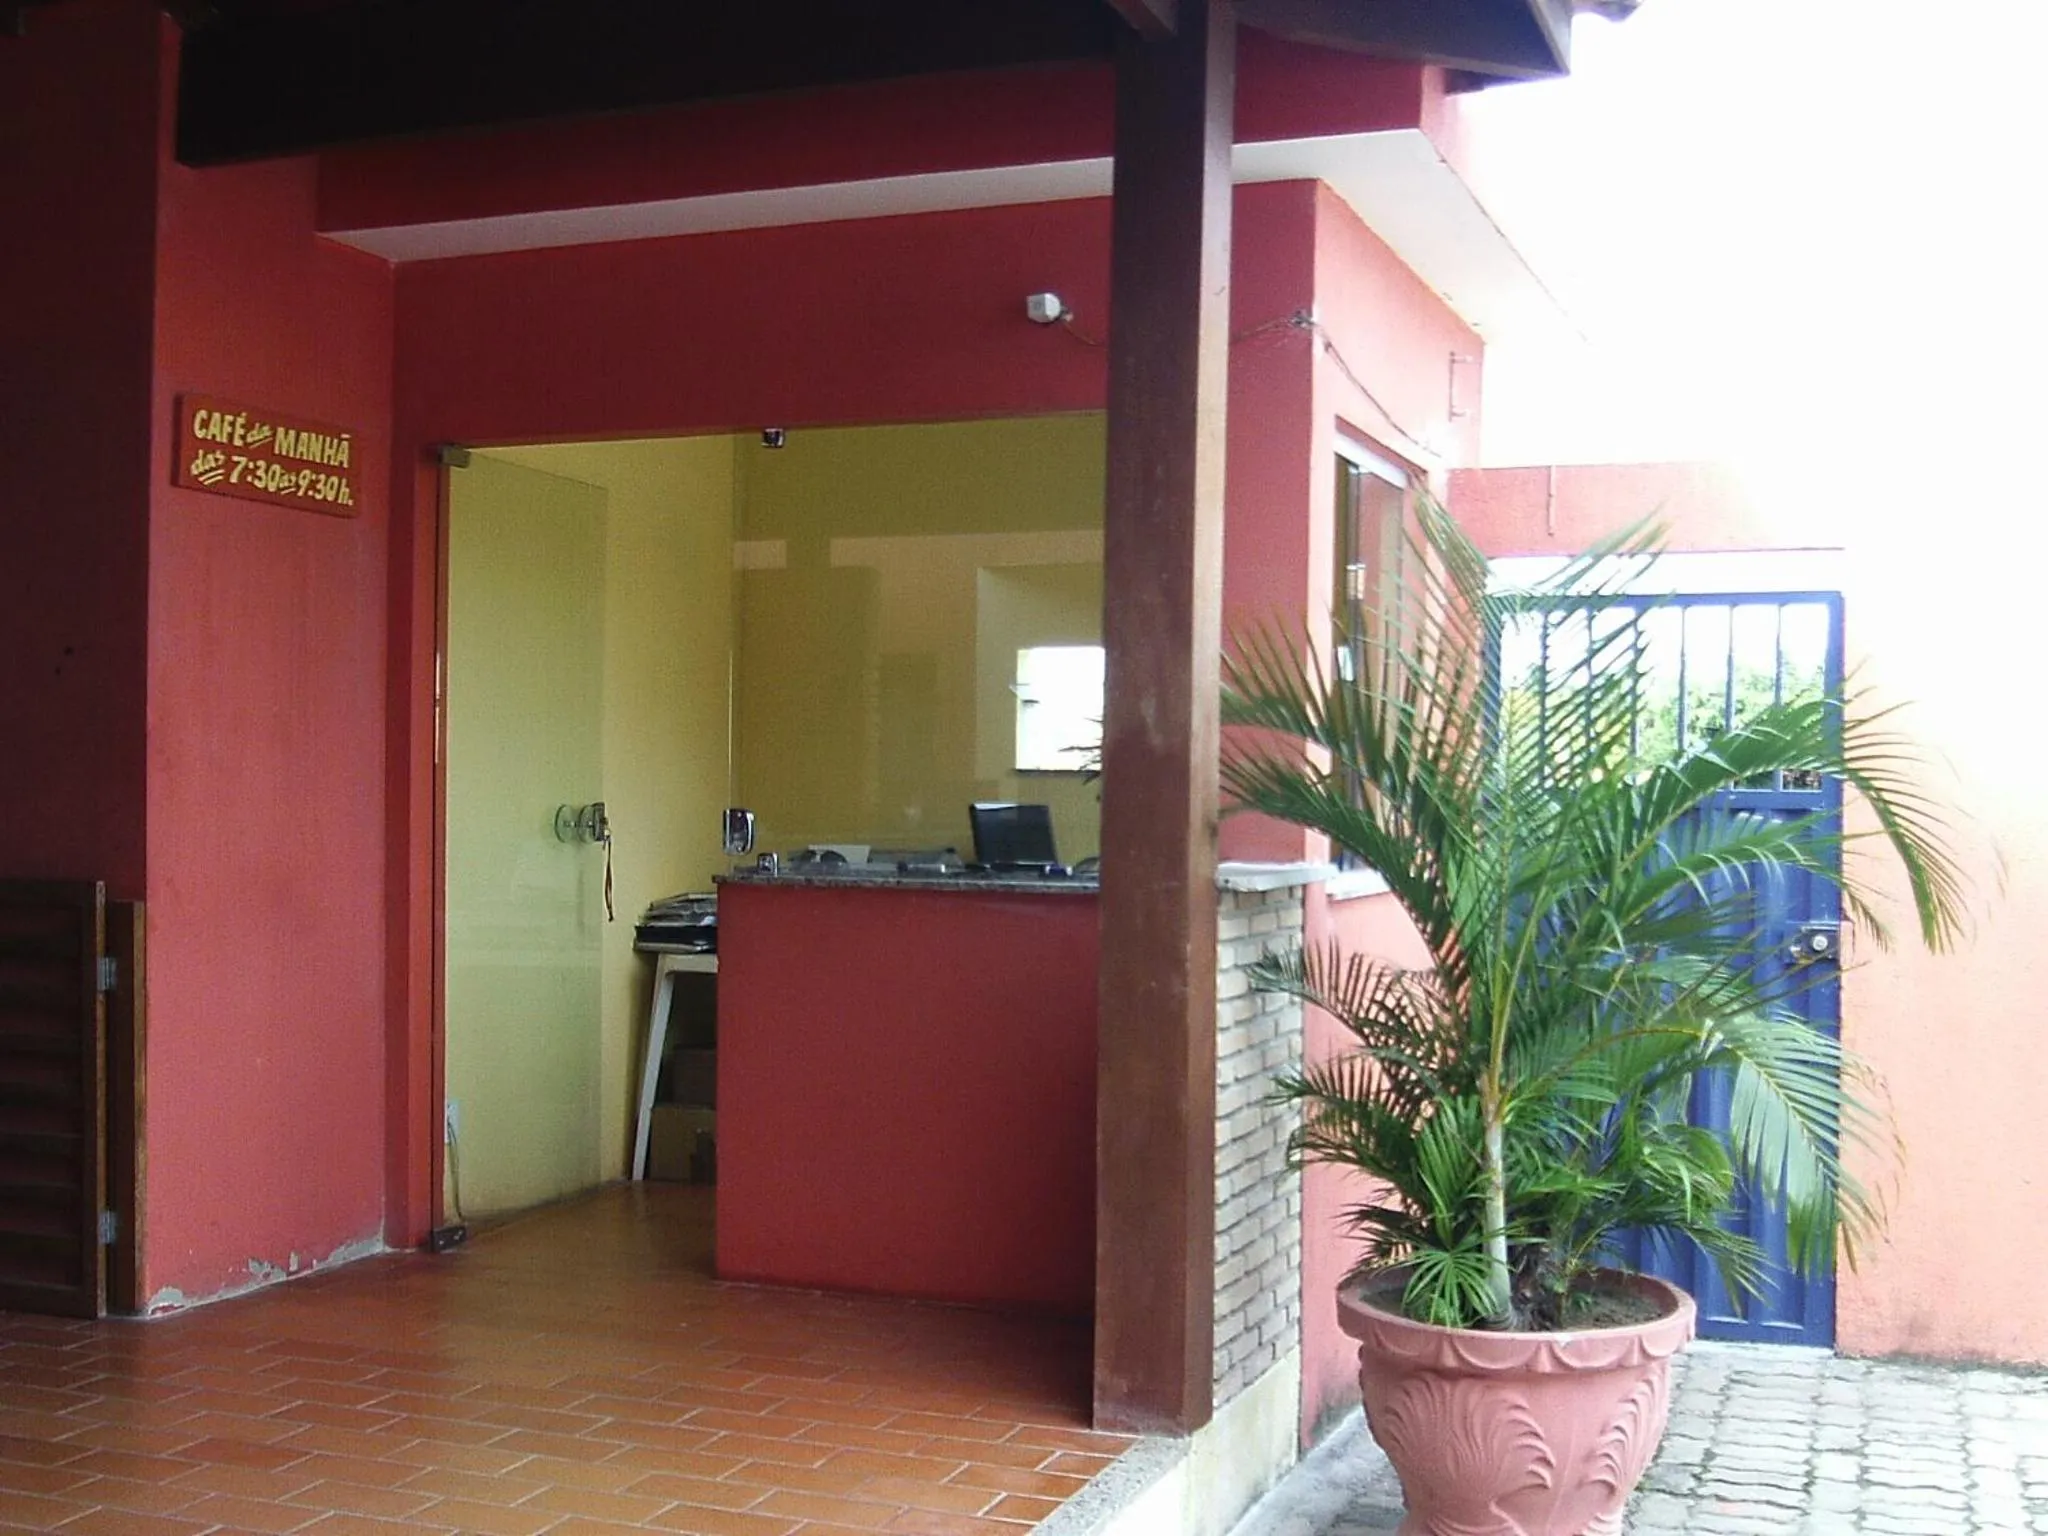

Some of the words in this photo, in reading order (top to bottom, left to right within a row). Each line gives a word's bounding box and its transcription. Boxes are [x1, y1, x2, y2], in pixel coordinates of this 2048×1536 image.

[194, 410, 247, 446] CAFÉ
[247, 423, 273, 443] da
[274, 427, 352, 468] MANHÃ
[191, 449, 226, 477] das
[229, 456, 281, 492] 7:30
